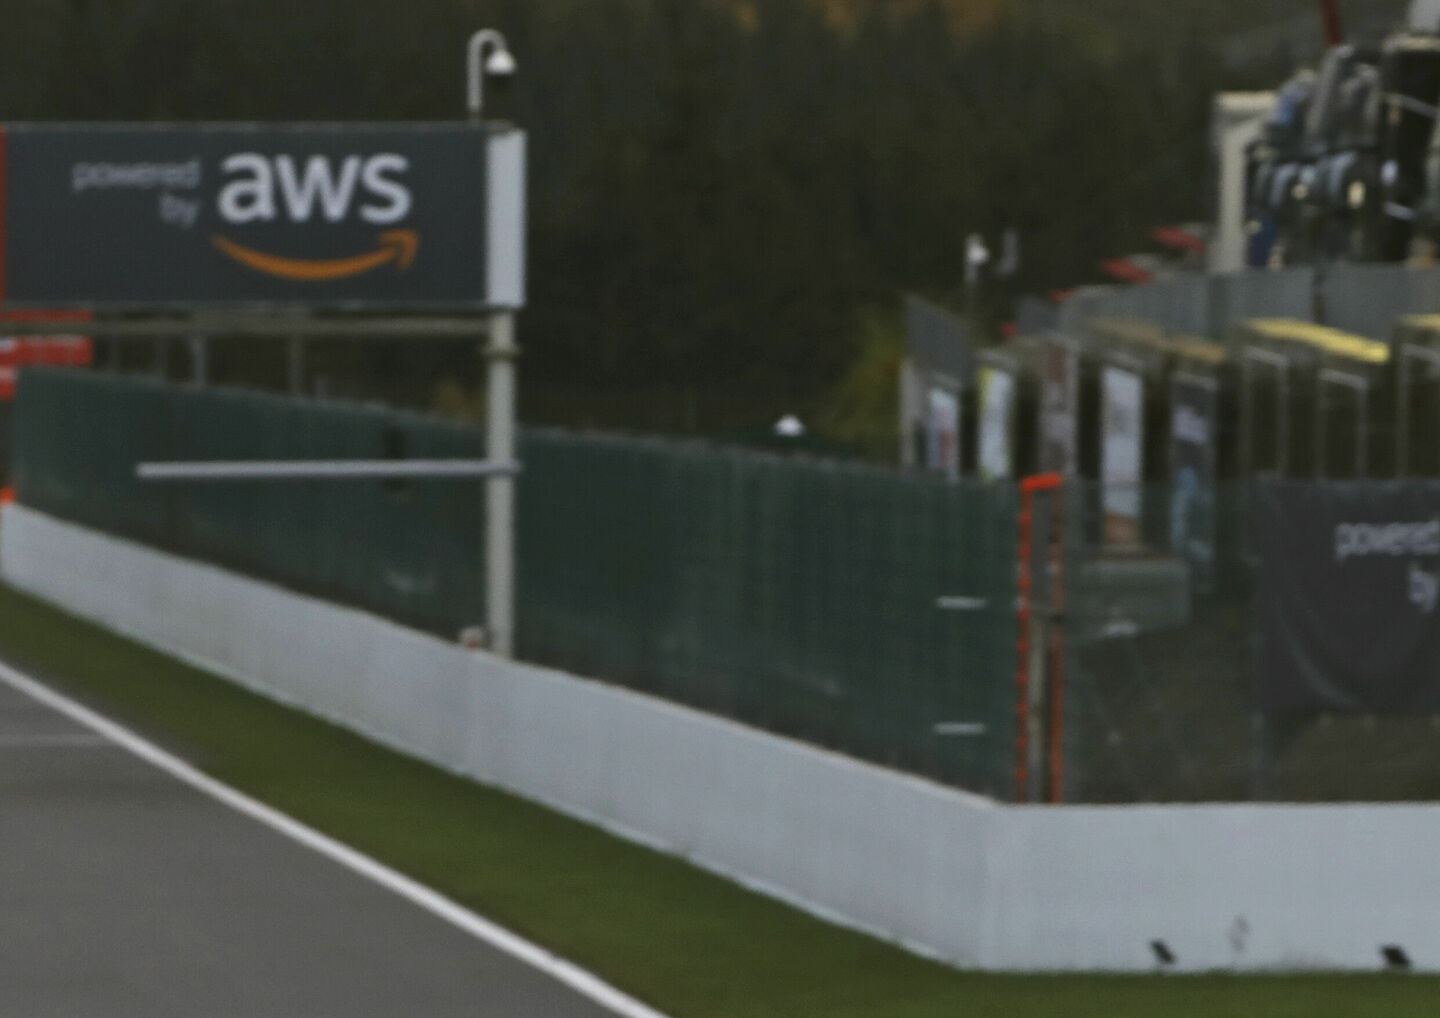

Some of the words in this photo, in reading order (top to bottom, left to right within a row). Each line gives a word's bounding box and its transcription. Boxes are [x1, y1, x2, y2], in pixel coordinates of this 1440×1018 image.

[71, 157, 202, 194] powered
[217, 152, 413, 223] aws
[159, 191, 200, 230] by
